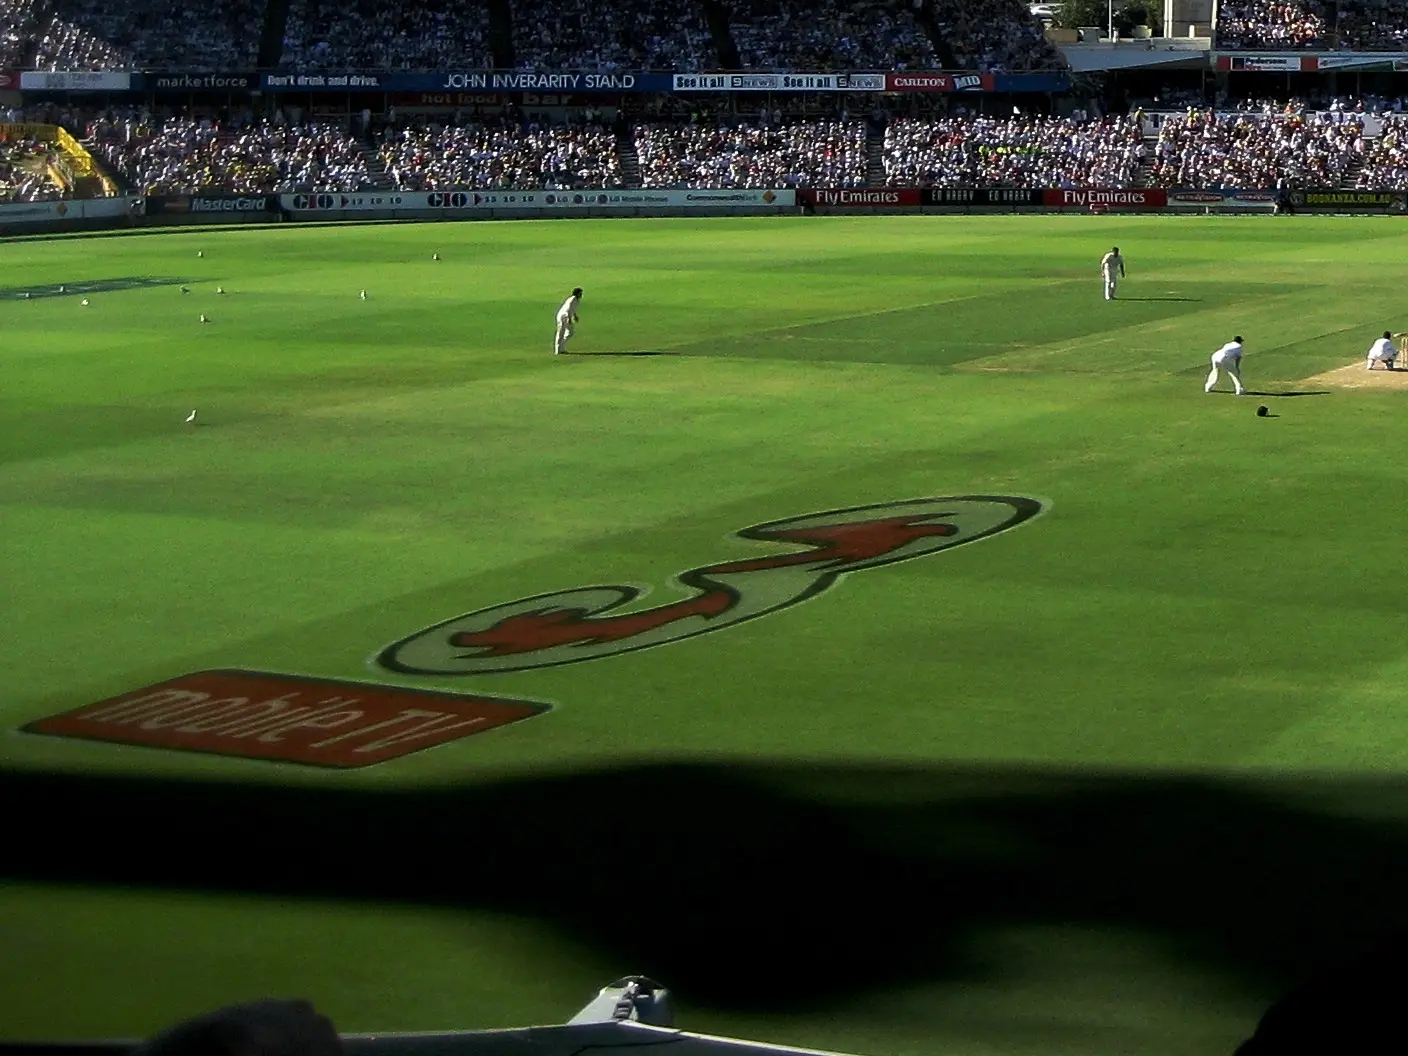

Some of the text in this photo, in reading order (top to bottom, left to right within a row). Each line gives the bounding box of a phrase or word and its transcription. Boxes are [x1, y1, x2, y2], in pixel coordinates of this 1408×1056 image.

[156, 74, 248, 89] marketforce
[267, 75, 295, 86] Don't
[297, 75, 326, 86] drink
[328, 75, 348, 86] and
[443, 74, 635, 89] JOHN INVERARITY STAND
[676, 75, 697, 88] See
[699, 75, 708, 88] it
[709, 75, 725, 88] all
[783, 76, 803, 89] See
[805, 76, 814, 89] it
[815, 76, 831, 89] all
[894, 77, 946, 88] CARLTON
[953, 75, 981, 89] MID
[457, 93, 498, 105] food
[522, 93, 573, 105] bar
[191, 196, 267, 212] MasterCard
[293, 194, 334, 209] GIO
[427, 193, 468, 207] GIO
[815, 190, 900, 206] Fly Emirates
[1063, 190, 1146, 205] Fly Emirates
